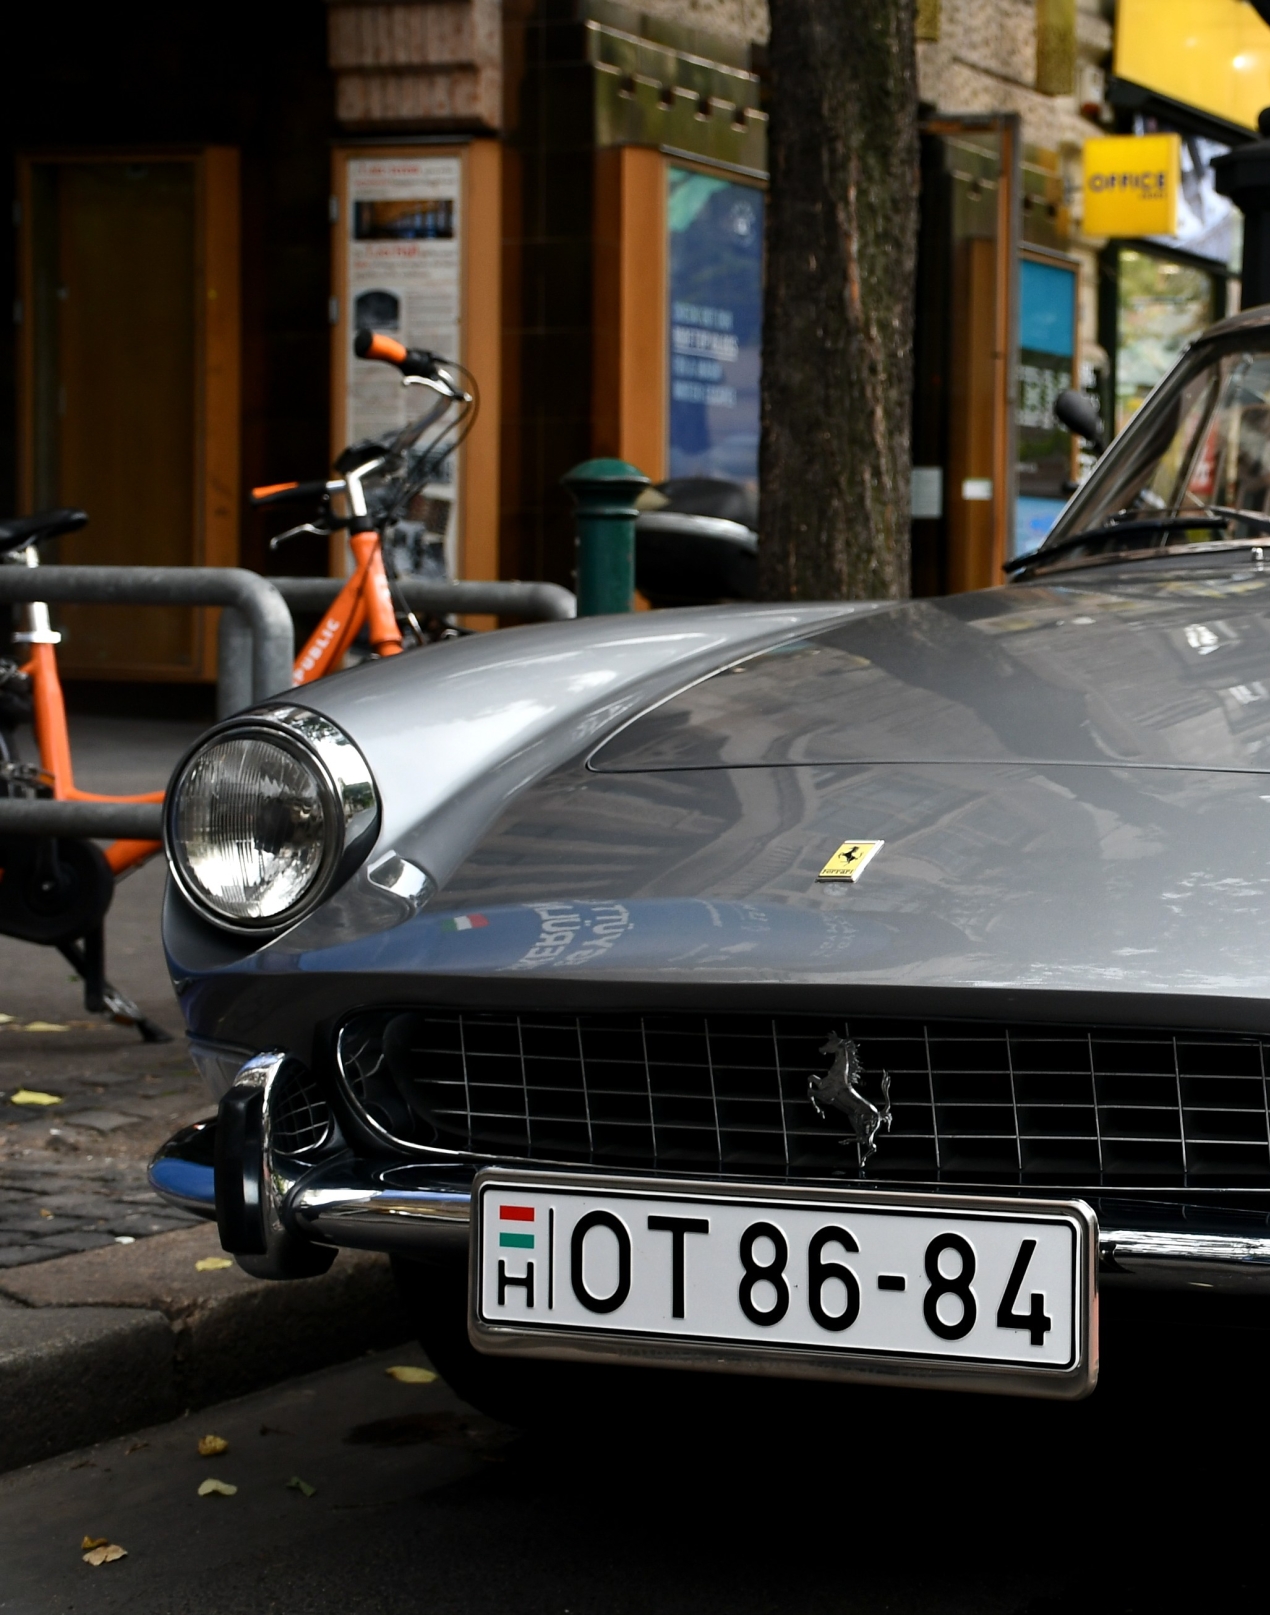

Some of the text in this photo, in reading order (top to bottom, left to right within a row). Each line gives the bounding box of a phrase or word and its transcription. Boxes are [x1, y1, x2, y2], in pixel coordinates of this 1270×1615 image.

[1089, 173, 1165, 192] OFFICE
[292, 618, 340, 688] PUBLIC
[497, 1259, 535, 1308] H
[570, 1209, 1052, 1347] OT 86-84
